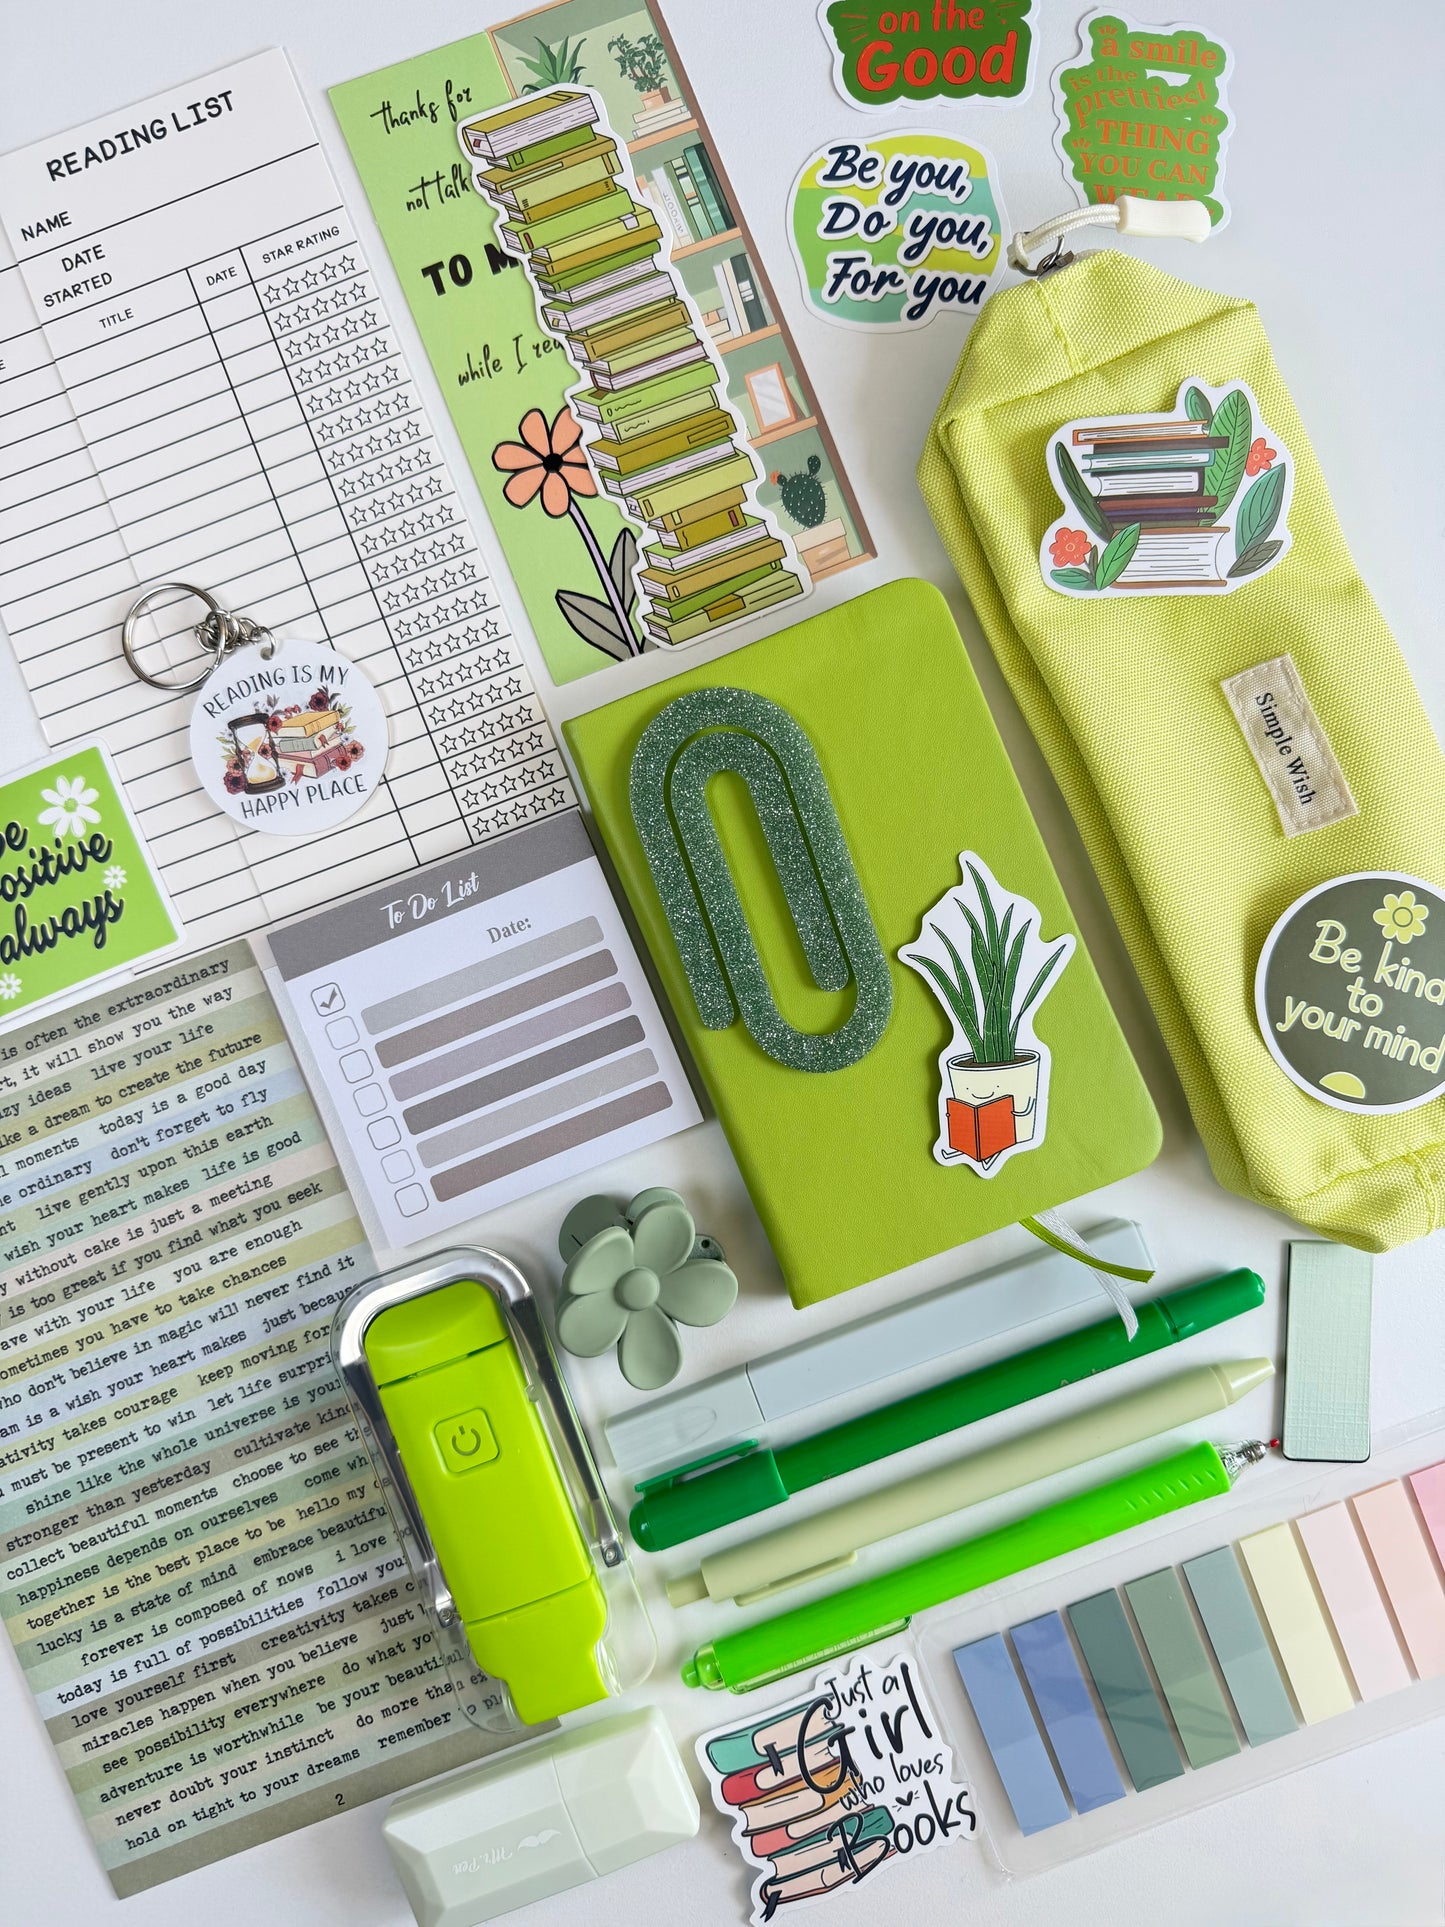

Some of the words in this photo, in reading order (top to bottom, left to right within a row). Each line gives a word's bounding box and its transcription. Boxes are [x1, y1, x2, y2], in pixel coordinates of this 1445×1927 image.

[878, 8, 920, 33] on
[932, 0, 984, 31] the
[856, 30, 1018, 92] Good
[1069, 74, 1092, 92] is
[1096, 66, 1138, 82] the
[1101, 38, 1120, 58] a
[1129, 39, 1217, 70] smile
[370, 90, 440, 134] thanks
[445, 80, 473, 122] for
[1074, 80, 1208, 130] prettiest
[46, 118, 168, 182] READING
[171, 90, 235, 133] LIST
[1096, 118, 1211, 156] THING
[406, 176, 430, 212] not
[430, 163, 471, 204] talk
[822, 144, 879, 183] Be
[885, 158, 967, 207] you,
[1079, 152, 1142, 178] YOU
[1148, 160, 1210, 186] CAN
[20, 210, 72, 242] NAME
[262, 244, 295, 264] STAR
[296, 226, 341, 251] RATING
[823, 202, 891, 236] Do
[903, 214, 988, 261] you,
[61, 244, 106, 272] DATE
[206, 266, 238, 286] DATE
[421, 253, 473, 297] TO
[484, 242, 520, 276] M
[43, 272, 113, 308] STARTED
[828, 256, 904, 298] For
[906, 276, 986, 321] you
[98, 308, 134, 330] TITLE
[458, 344, 504, 388] while
[512, 334, 528, 375] I
[532, 337, 564, 359] rea
[202, 667, 286, 719] READING
[291, 664, 313, 684] IS
[319, 664, 350, 686] MY
[1255, 692, 1293, 756] Simple
[1286, 755, 1318, 806] Wish
[240, 788, 300, 820] HAPPY
[306, 774, 368, 804] PLACE
[0, 832, 114, 903] ositive
[0, 889, 125, 966] always
[379, 899, 406, 930] To
[407, 892, 438, 920] Do
[440, 871, 480, 908] List
[486, 917, 532, 944] Date:
[1308, 919, 1362, 974] Be
[0, 1046, 18, 1061] is
[24, 1026, 68, 1050] often
[72, 1012, 101, 1029] the
[107, 959, 229, 1016] extraordinary
[1346, 976, 1384, 1018] to
[1276, 996, 1362, 1042] your
[1364, 1024, 1445, 1074] mind
[27, 1081, 72, 1107] ideas
[89, 1059, 127, 1080] live
[131, 1040, 172, 1066] your
[177, 1023, 214, 1044] life
[27, 1124, 39, 1136] a
[43, 1103, 91, 1129] dream
[94, 1094, 112, 1107] to
[117, 1070, 170, 1098] create
[174, 1057, 203, 1074] the
[207, 1033, 262, 1062] future
[17, 1159, 92, 1198] ordinary
[110, 1135, 150, 1160] don't
[155, 1110, 211, 1142] forget
[214, 1103, 234, 1116] to
[240, 1088, 267, 1107] fly
[3, 1239, 41, 1261] wish
[45, 1221, 84, 1247] your
[89, 1198, 138, 1227] heart
[142, 1178, 190, 1205] makes
[200, 1159, 237, 1181] life
[241, 1149, 260, 1165] is
[265, 1130, 302, 1157] good
[7, 1304, 26, 1319] is
[29, 1292, 56, 1309] too
[61, 1269, 107, 1300] great
[110, 1259, 127, 1277] if
[133, 1248, 163, 1270] you
[166, 1228, 203, 1254] find
[207, 1211, 247, 1236] what
[251, 1199, 282, 1221] you
[286, 1181, 323, 1204] seek
[33, 1314, 72, 1336] with
[75, 1296, 115, 1322] your
[119, 1280, 156, 1301] life
[172, 1261, 203, 1283] you
[208, 1246, 238, 1265] are
[244, 1219, 303, 1251] enough
[27, 1372, 66, 1397] don't
[67, 1349, 128, 1379] believe
[132, 1339, 153, 1355] in
[157, 1319, 203, 1344] magic
[207, 1301, 239, 1323] will
[244, 1282, 290, 1309] never
[295, 1263, 332, 1288] find
[336, 1254, 355, 1271] it
[25, 1488, 72, 1515] shine
[75, 1471, 113, 1493] like
[117, 1458, 146, 1476] the
[151, 1436, 198, 1462] whole
[203, 1405, 276, 1441] universe
[282, 1395, 300, 1410] is
[5, 1513, 79, 1552] stronger
[85, 1495, 126, 1518] than
[130, 1459, 211, 1503] yesterday
[233, 1420, 311, 1458] cultivate
[15, 1563, 100, 1606] happiness
[106, 1536, 168, 1568] depends
[173, 1526, 194, 1541] on
[199, 1491, 278, 1530] ourselves
[303, 1466, 340, 1488] come
[35, 1627, 83, 1655] lucky
[89, 1618, 108, 1633] is
[113, 1611, 125, 1623] a
[129, 1592, 172, 1617] state
[176, 1580, 193, 1597] of
[199, 1563, 238, 1588] mind
[252, 1535, 314, 1566] embrace
[56, 1677, 102, 1704] today
[109, 1668, 128, 1683] is
[132, 1649, 171, 1674] full
[175, 1639, 192, 1656] of
[197, 1596, 304, 1649] possibilities
[316, 1570, 368, 1600] follow
[80, 1715, 154, 1753] miracles
[157, 1690, 216, 1720] happen
[220, 1672, 261, 1694] when
[265, 1658, 296, 1680] you
[297, 1632, 358, 1663] believe
[379, 1608, 414, 1633] just
[823, 1664, 872, 1720] Just
[882, 1674, 900, 1695] a
[99, 1761, 184, 1803] adventure
[188, 1751, 207, 1766] is
[212, 1712, 304, 1756] worthwhile
[315, 1699, 336, 1714] be
[341, 1681, 380, 1708] your
[797, 1662, 933, 1794] Girl
[334, 1792, 345, 1806] 2
[839, 1769, 885, 1811] who
[888, 1752, 944, 1784] loves
[826, 1780, 977, 1884] Books
